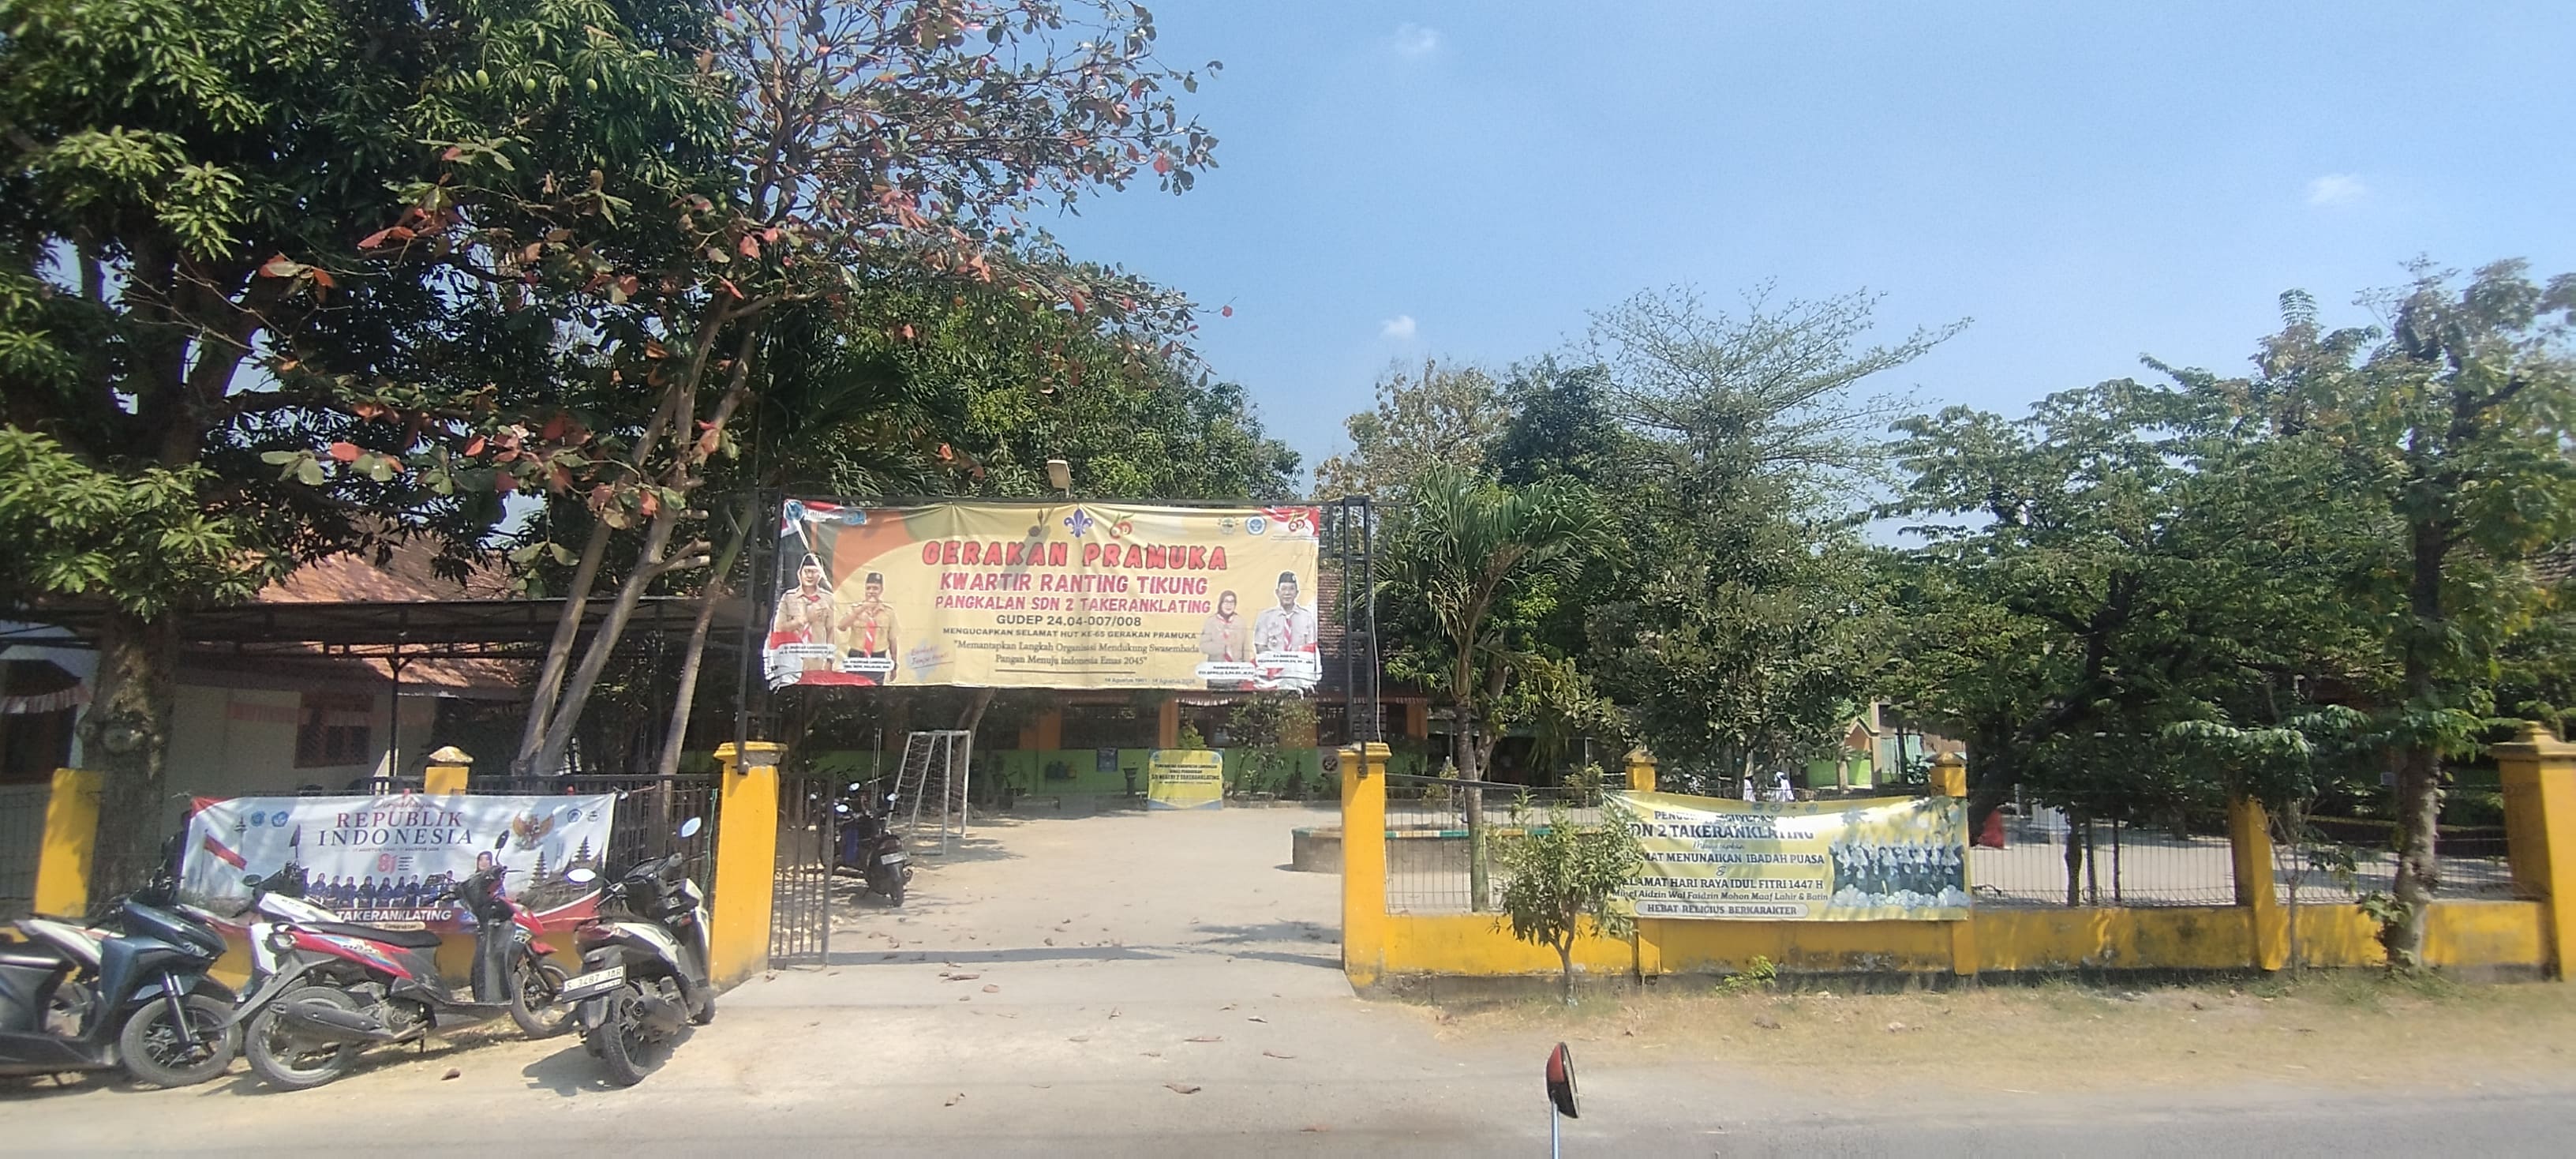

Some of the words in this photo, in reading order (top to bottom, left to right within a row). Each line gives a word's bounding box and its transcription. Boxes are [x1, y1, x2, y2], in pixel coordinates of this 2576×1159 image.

[922, 541, 1068, 566] GERAKAN
[1082, 542, 1227, 570] PRAMUKA
[940, 572, 1032, 591] KWARTIR
[1040, 573, 1129, 593] RANTING
[1136, 576, 1208, 595] TIKUNG
[935, 595, 1026, 610] PANGKALAN
[1031, 596, 1060, 611] SDN
[1065, 598, 1074, 612] 2
[1080, 598, 1211, 613] TAKERANKLATING
[997, 614, 1043, 625] GUDEP
[1046, 616, 1142, 627] 24.04-007/008
[942, 628, 1013, 636] MENGUCAPKAN
[1019, 641, 1054, 652] Langkah
[1099, 643, 1148, 655] Mendukung
[995, 655, 1025, 665] Pangan
[1028, 655, 1058, 666] Menuju
[336, 812, 463, 828] REPUBLIK
[318, 828, 474, 846] INDONESIA
[1630, 823, 1654, 837] DN
[1657, 823, 1668, 838] 2
[1667, 853, 1743, 863] MENUNAIKAN
[1746, 853, 1788, 864] IBADAH
[1790, 854, 1825, 865] PUASA
[1670, 878, 1698, 887] HARI
[1701, 879, 1729, 888] RAYA
[1730, 879, 1757, 888] IDUL
[1758, 880, 1787, 889] FITRI
[1789, 880, 1814, 890] 1447
[1816, 880, 1823, 889] H
[1638, 890, 1667, 898] Aidzin
[1751, 892, 1773, 902] Maaf
[335, 910, 452, 922] TAKERANKLATING
[1647, 904, 1679, 913] HEBAT
[1682, 905, 1725, 914] RELIGIUS
[1728, 906, 1798, 915] BERKARAKTER
